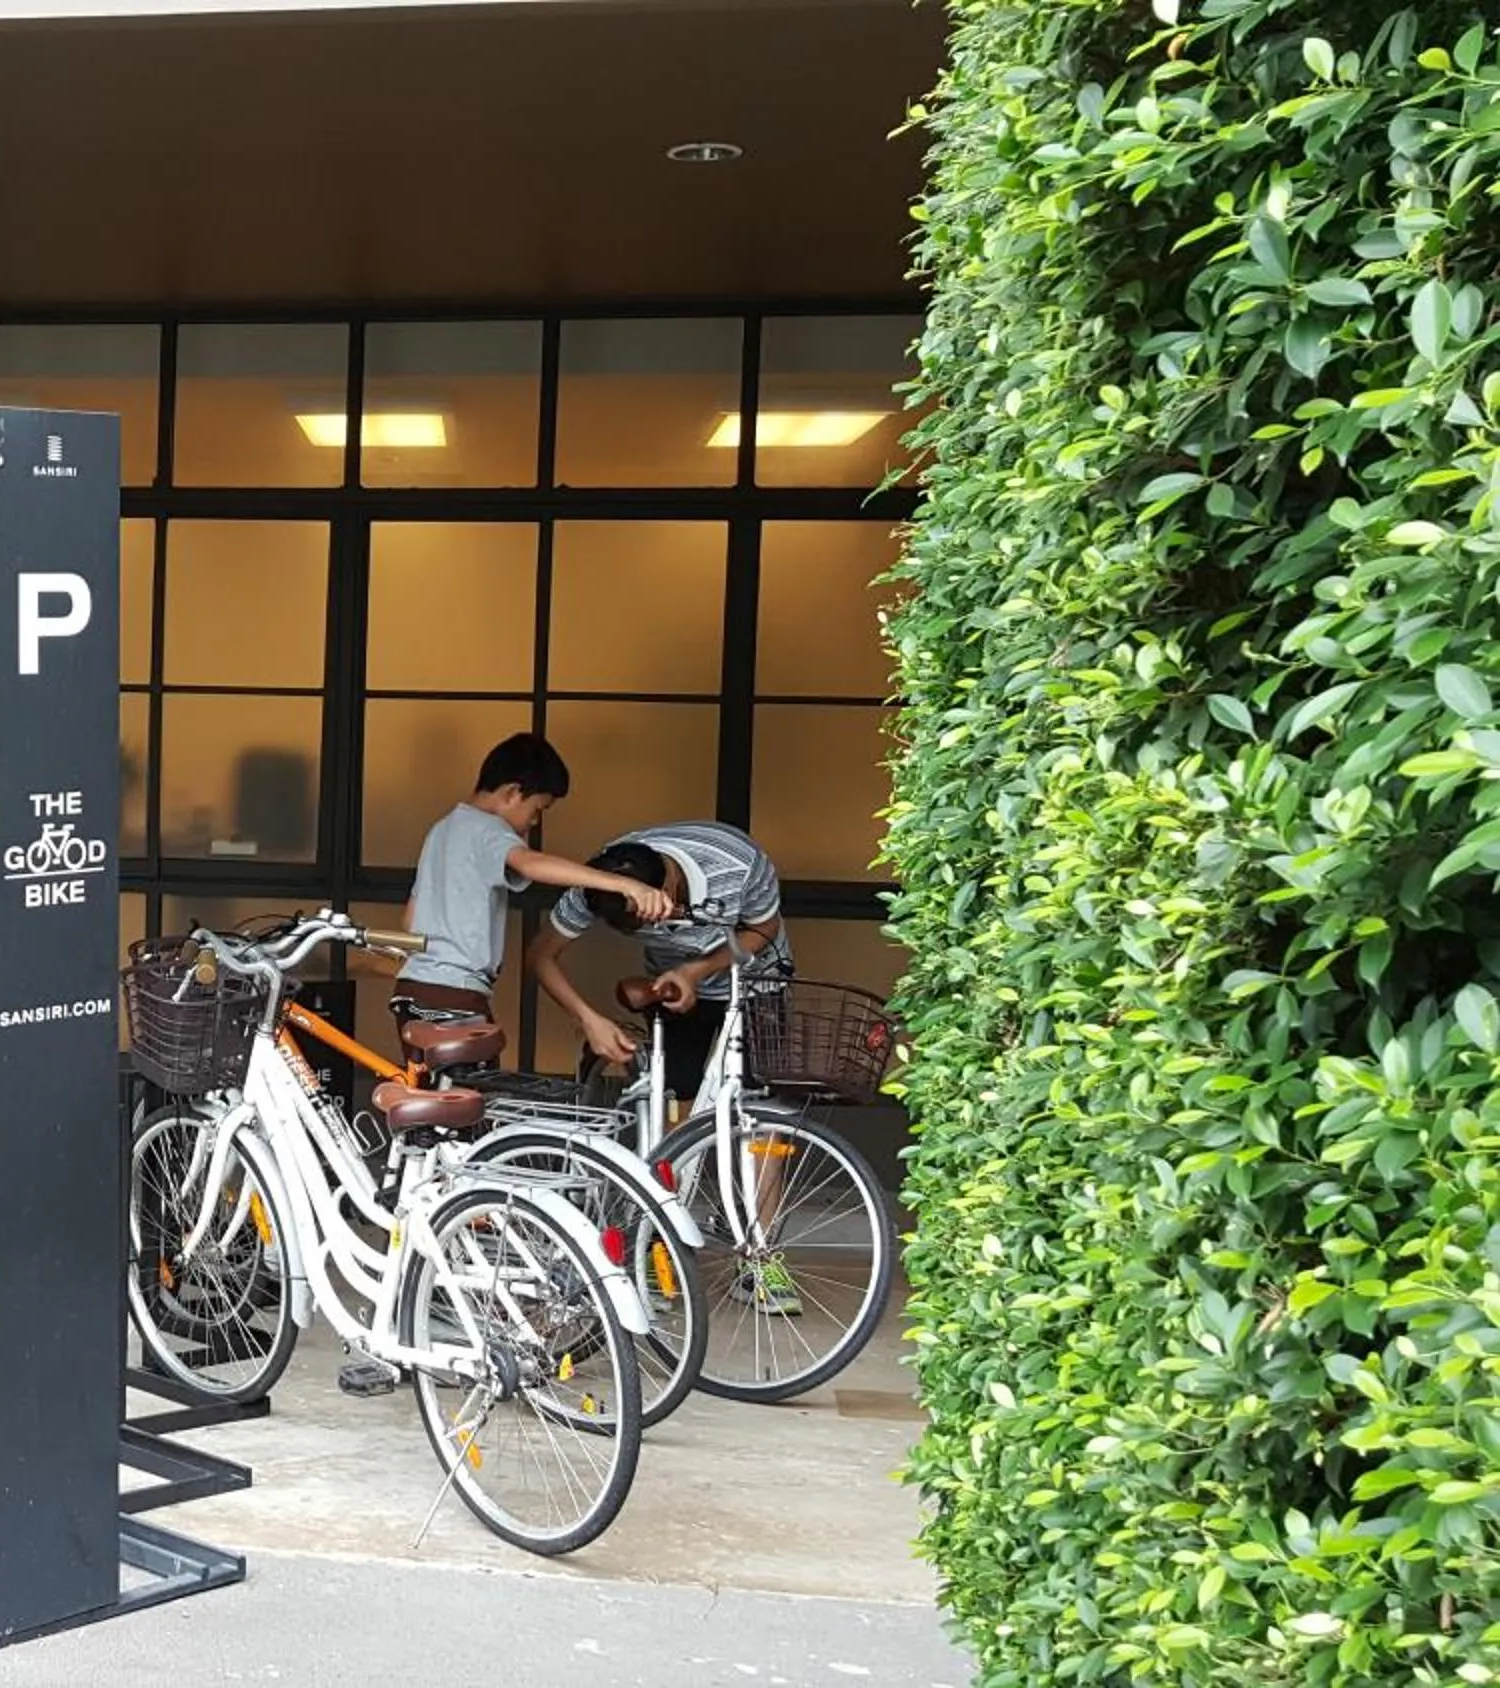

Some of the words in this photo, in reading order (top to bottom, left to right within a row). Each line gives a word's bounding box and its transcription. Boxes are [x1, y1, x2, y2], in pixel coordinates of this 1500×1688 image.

[32, 465, 78, 478] SANSIRI
[18, 573, 92, 675] P
[29, 791, 82, 817] THE
[24, 880, 86, 908] BIKE
[0, 999, 111, 1027] SANSIRI.COM
